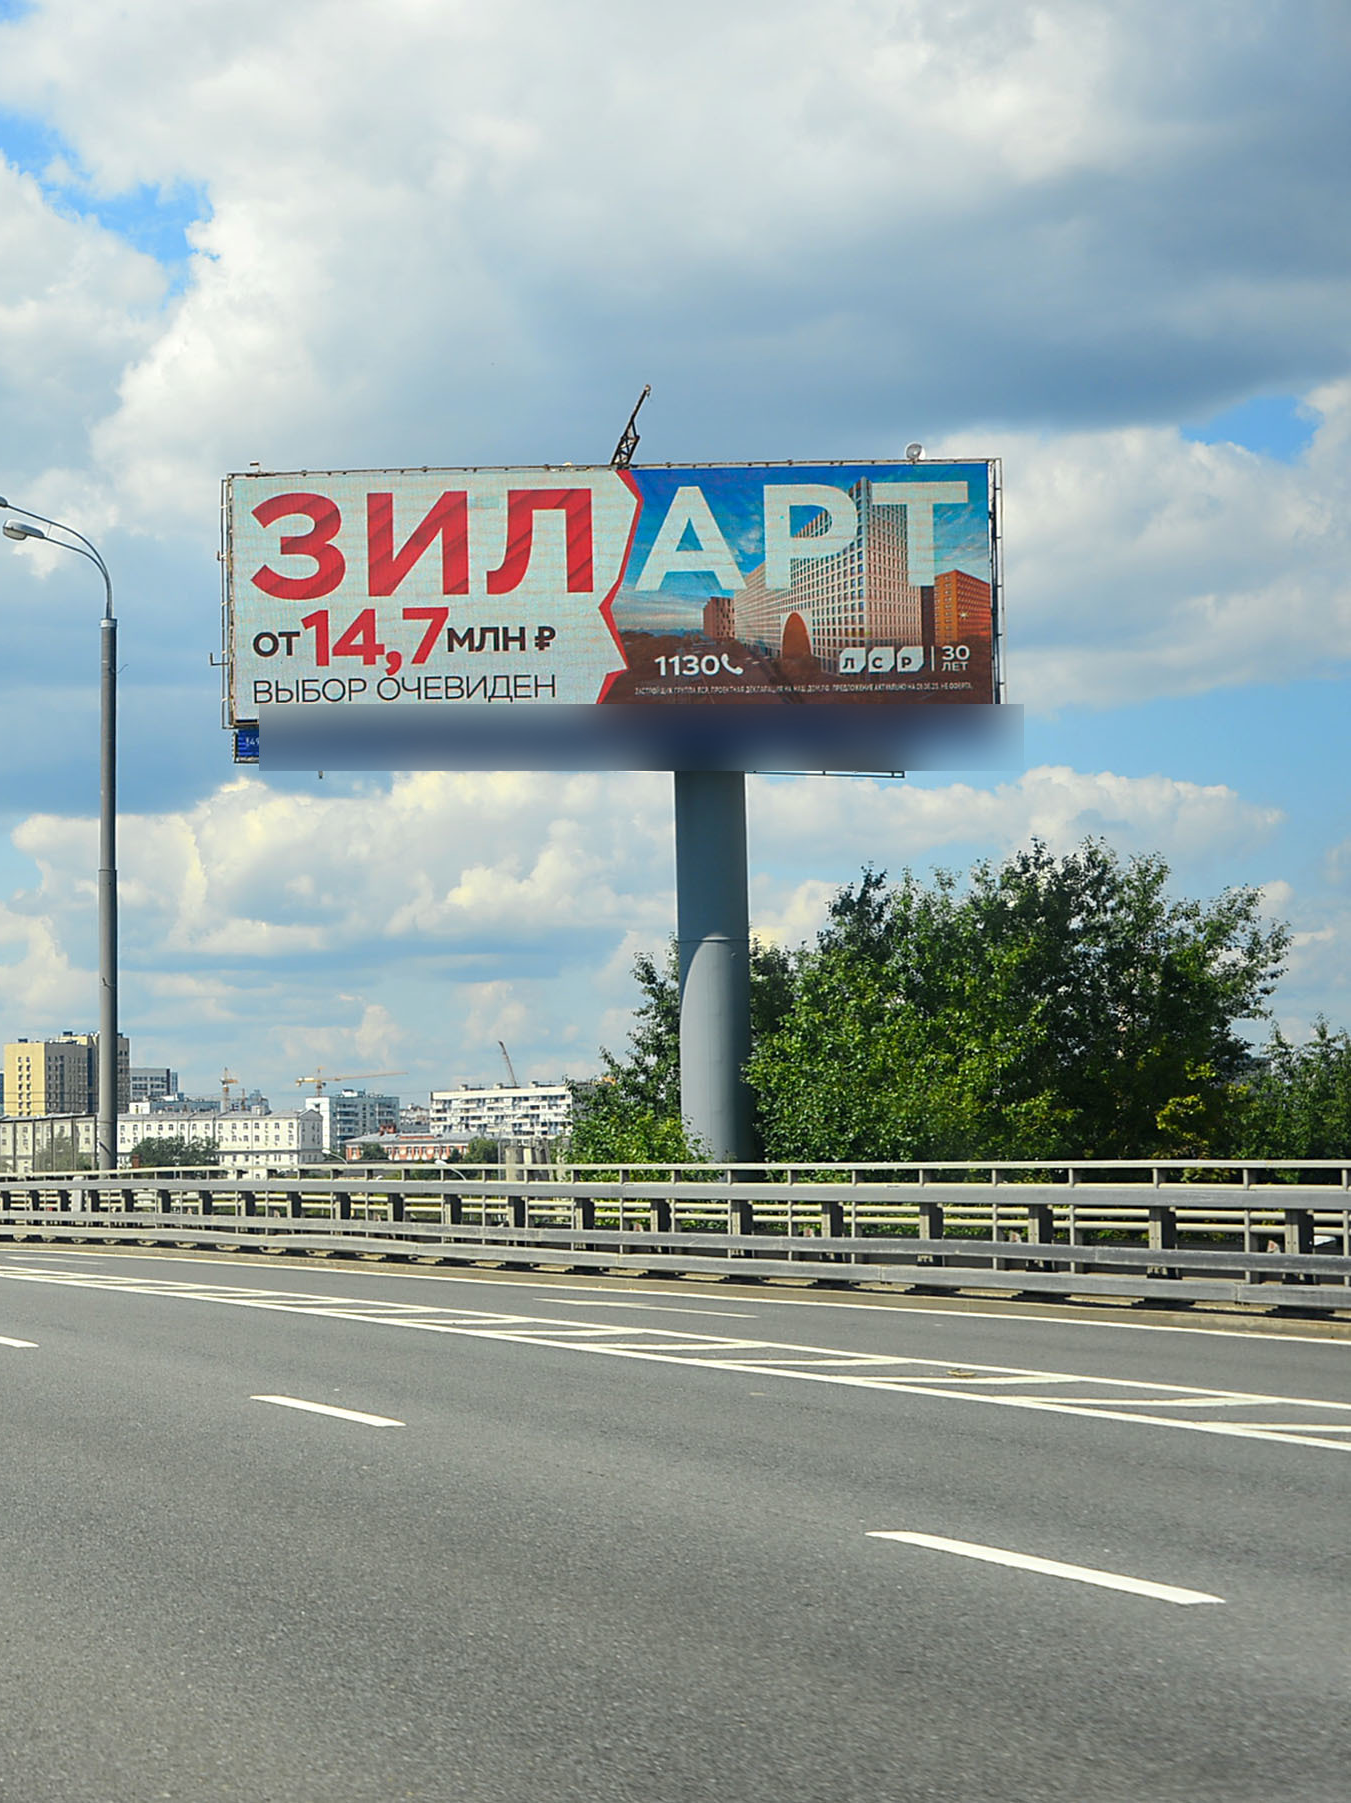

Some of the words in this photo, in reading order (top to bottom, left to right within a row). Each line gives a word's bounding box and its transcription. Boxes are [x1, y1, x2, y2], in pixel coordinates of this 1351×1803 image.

[250, 488, 594, 601] ЗИЛ
[634, 480, 969, 591] АРТ
[301, 607, 449, 675] 14,7
[446, 627, 526, 654] МЛН
[941, 645, 970, 661] 30
[654, 654, 722, 677] 1130
[941, 661, 969, 672] ЛЕТ
[253, 677, 367, 704] ВЫБОР
[376, 673, 556, 704] ОЧЕВИДЕН
